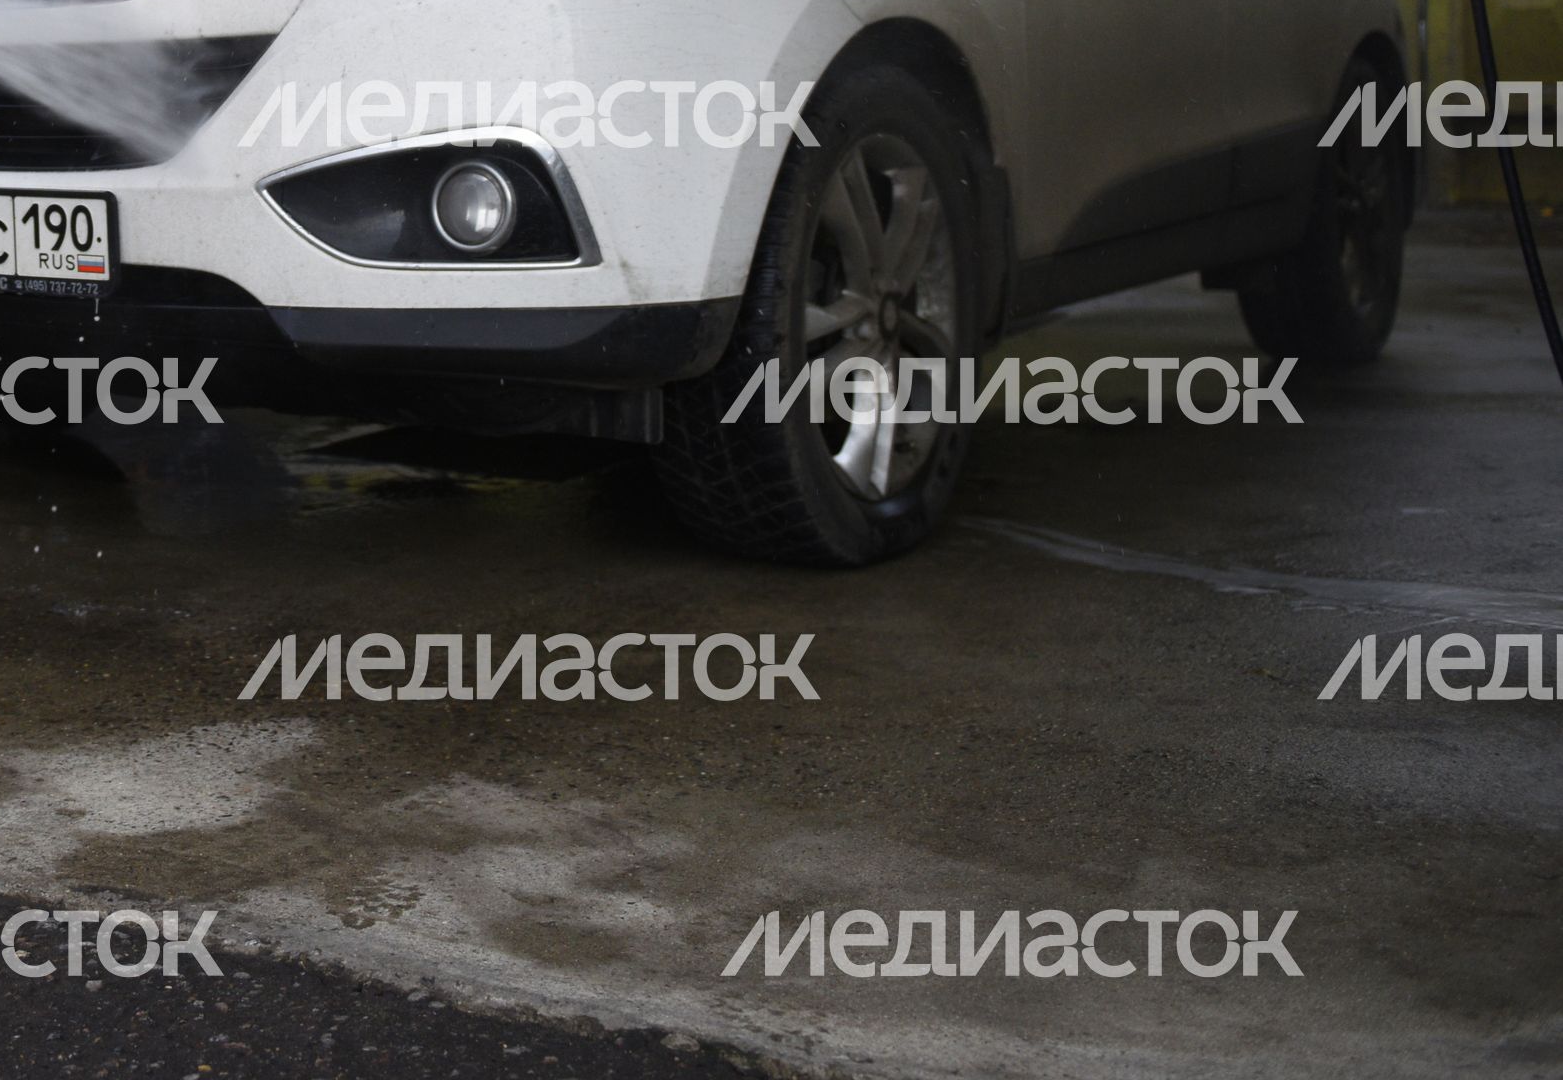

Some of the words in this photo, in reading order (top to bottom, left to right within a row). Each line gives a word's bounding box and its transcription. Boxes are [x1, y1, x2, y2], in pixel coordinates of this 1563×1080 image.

[22, 202, 95, 252] 190
[38, 253, 76, 272] RUS
[49, 281, 100, 296] 737-72-72
